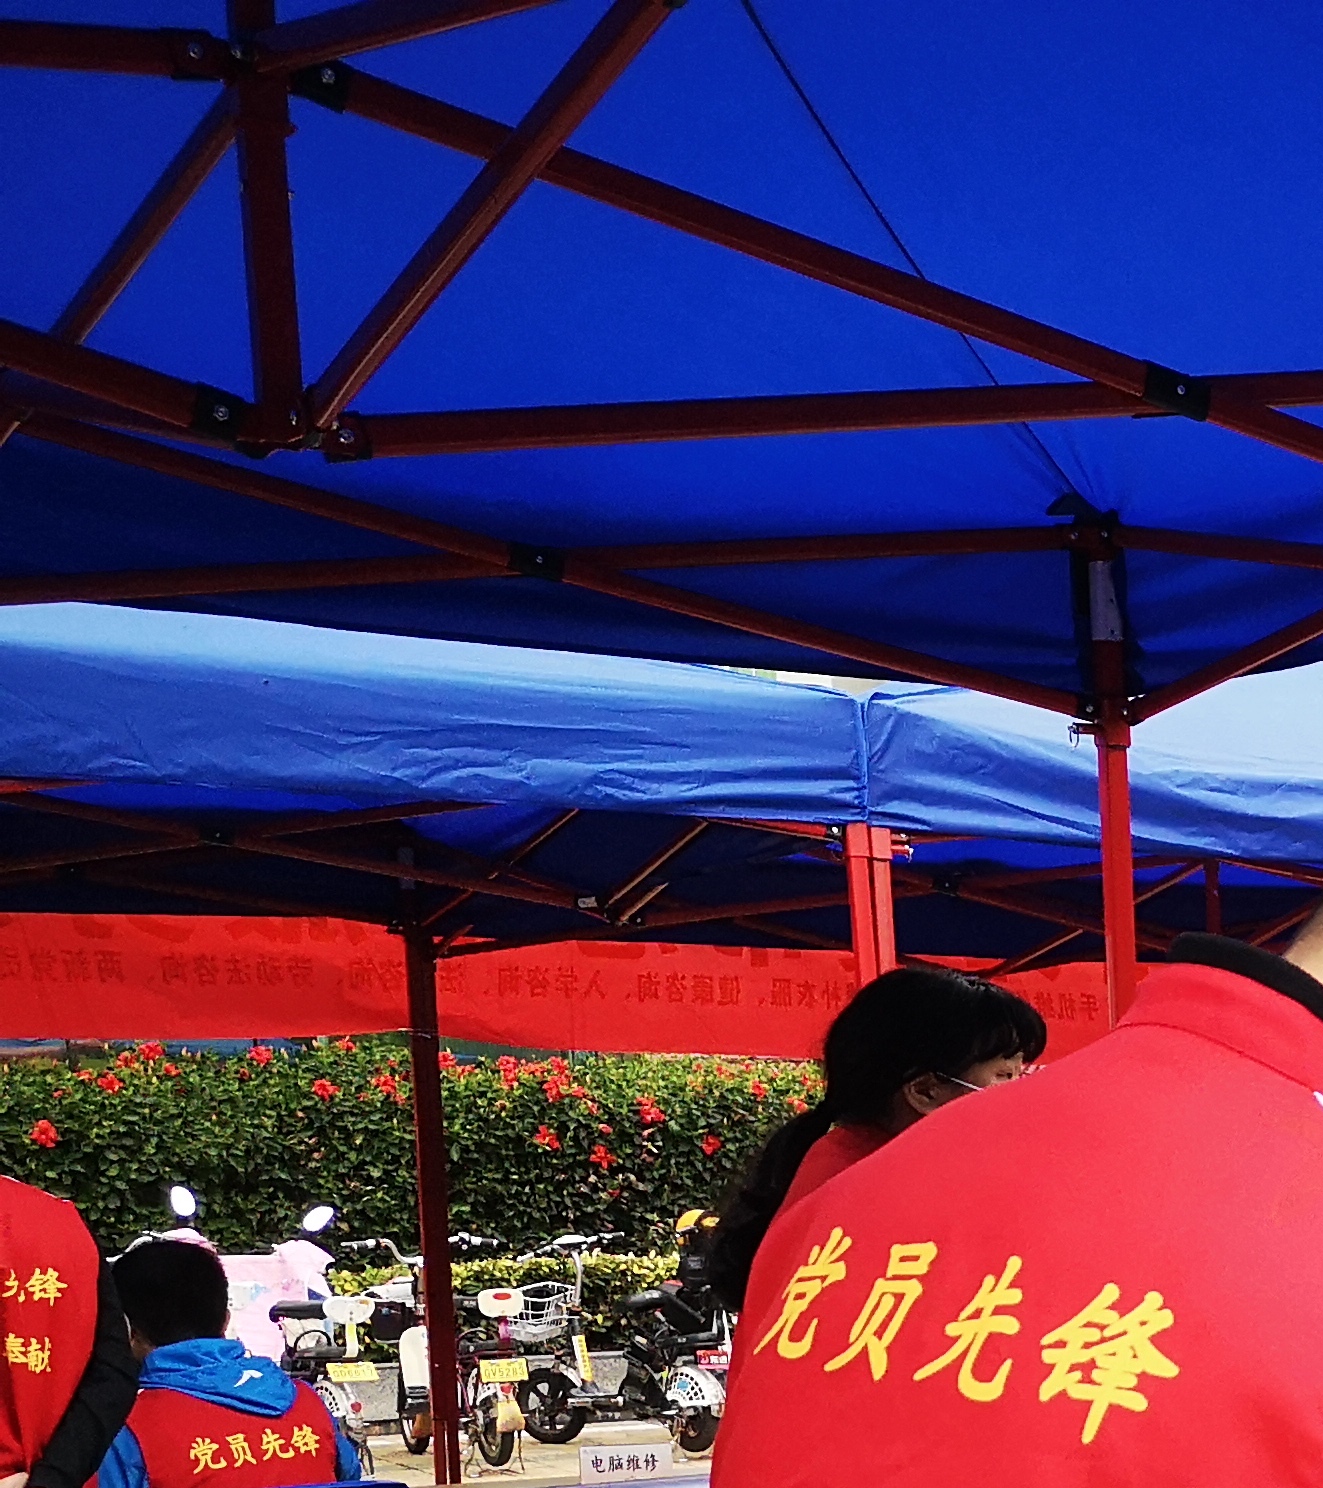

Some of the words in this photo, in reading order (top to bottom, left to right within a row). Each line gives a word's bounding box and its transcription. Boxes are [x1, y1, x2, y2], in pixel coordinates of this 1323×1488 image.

[754, 1226, 1181, 1445] 党员先锋
[189, 1424, 321, 1475] 党员先锋
[591, 1453, 659, 1474] 电脑维修
